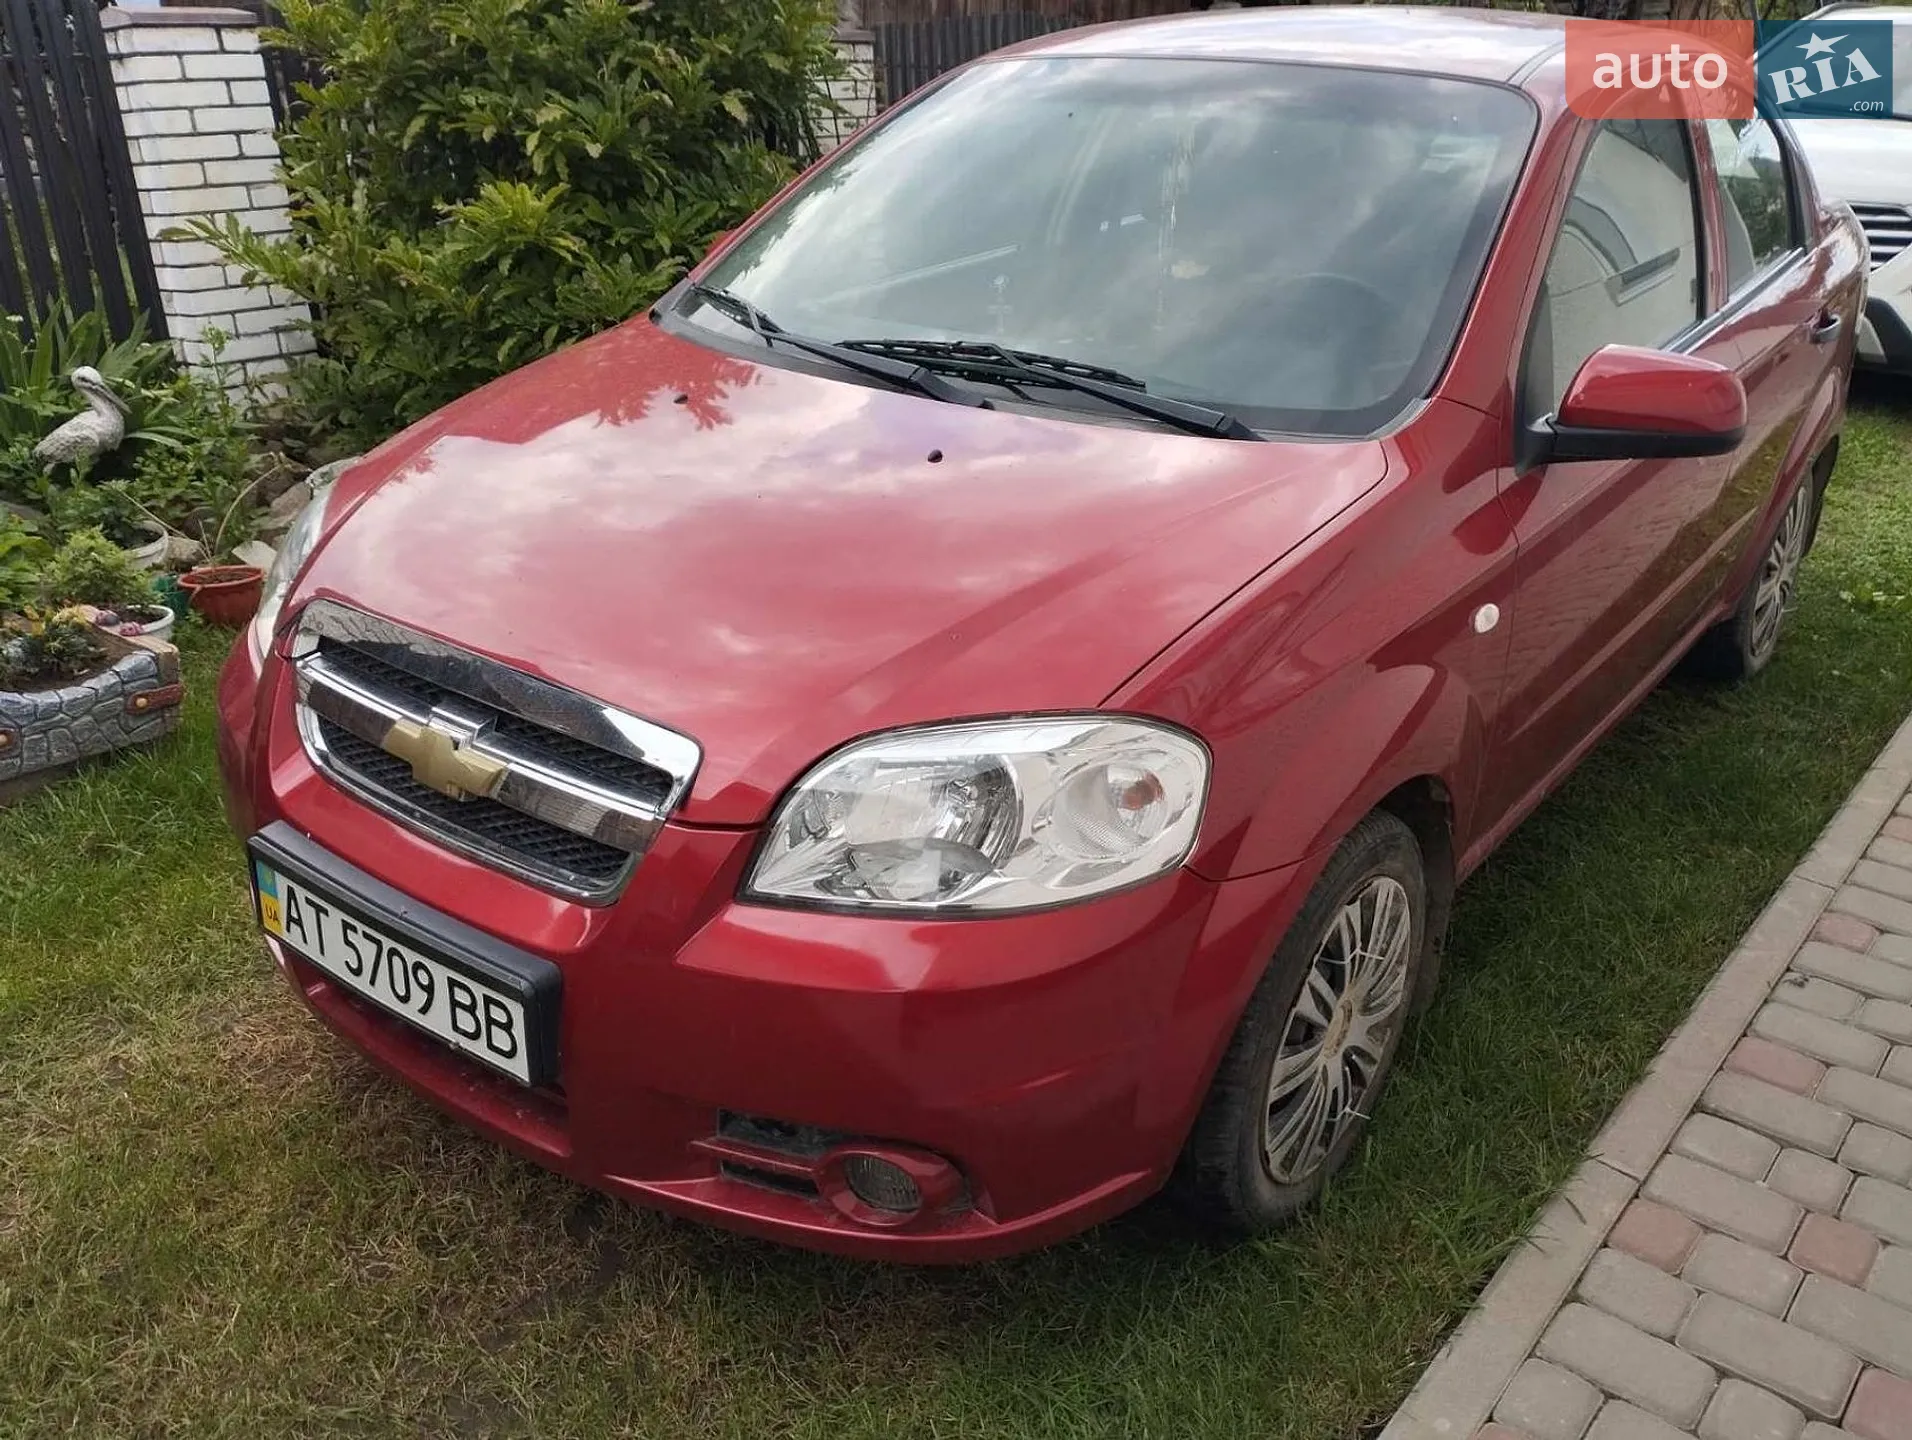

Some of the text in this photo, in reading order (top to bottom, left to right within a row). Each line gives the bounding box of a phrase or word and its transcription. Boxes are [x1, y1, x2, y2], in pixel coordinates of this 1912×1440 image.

[264, 904, 281, 925] UA
[285, 884, 518, 1060] AT 5709 BB
